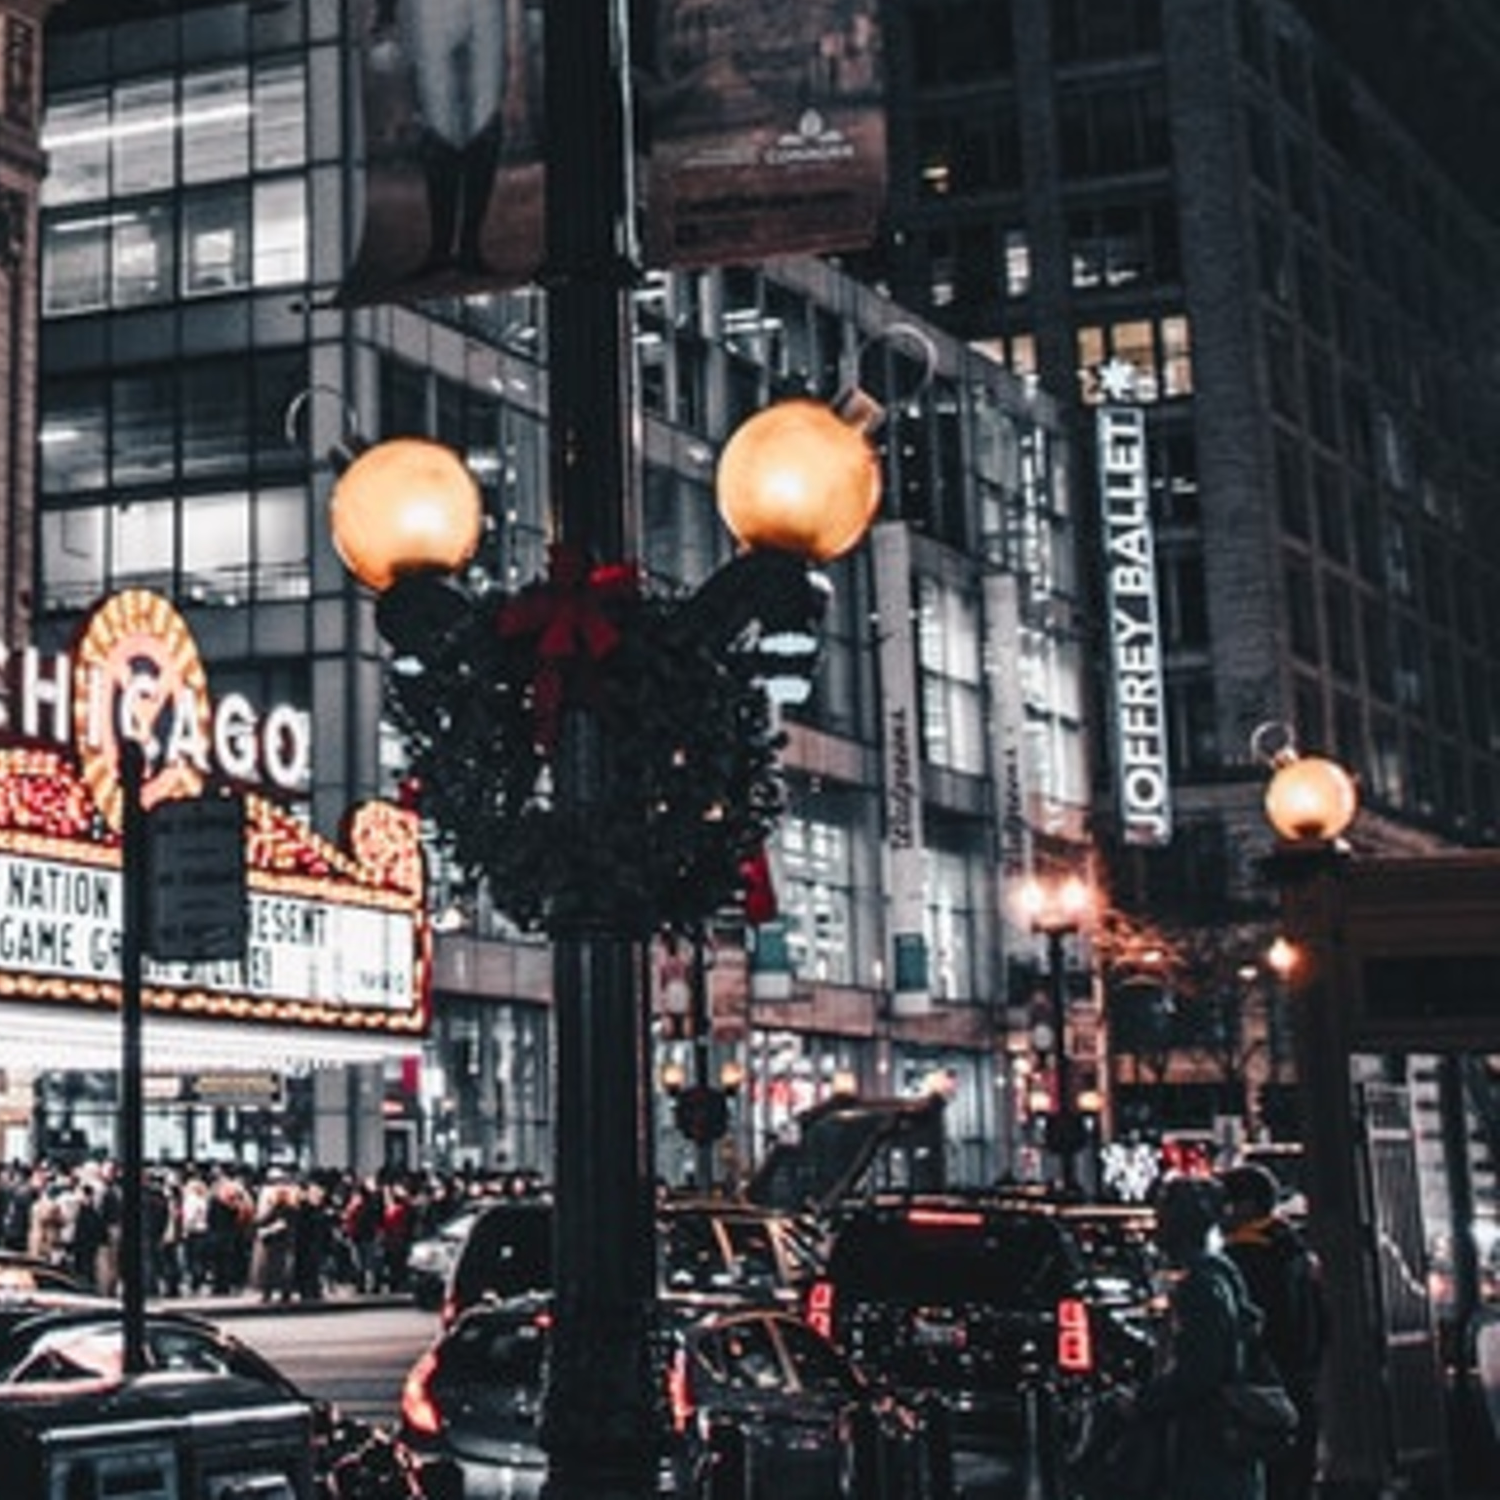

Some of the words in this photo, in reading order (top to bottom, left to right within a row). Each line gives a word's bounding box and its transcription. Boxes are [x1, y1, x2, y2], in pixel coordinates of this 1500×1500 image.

[1103, 411, 1151, 596] BALLET
[1113, 610, 1168, 842] JOFFREY
[6, 866, 110, 918] NATION
[248, 900, 327, 947] ESENT
